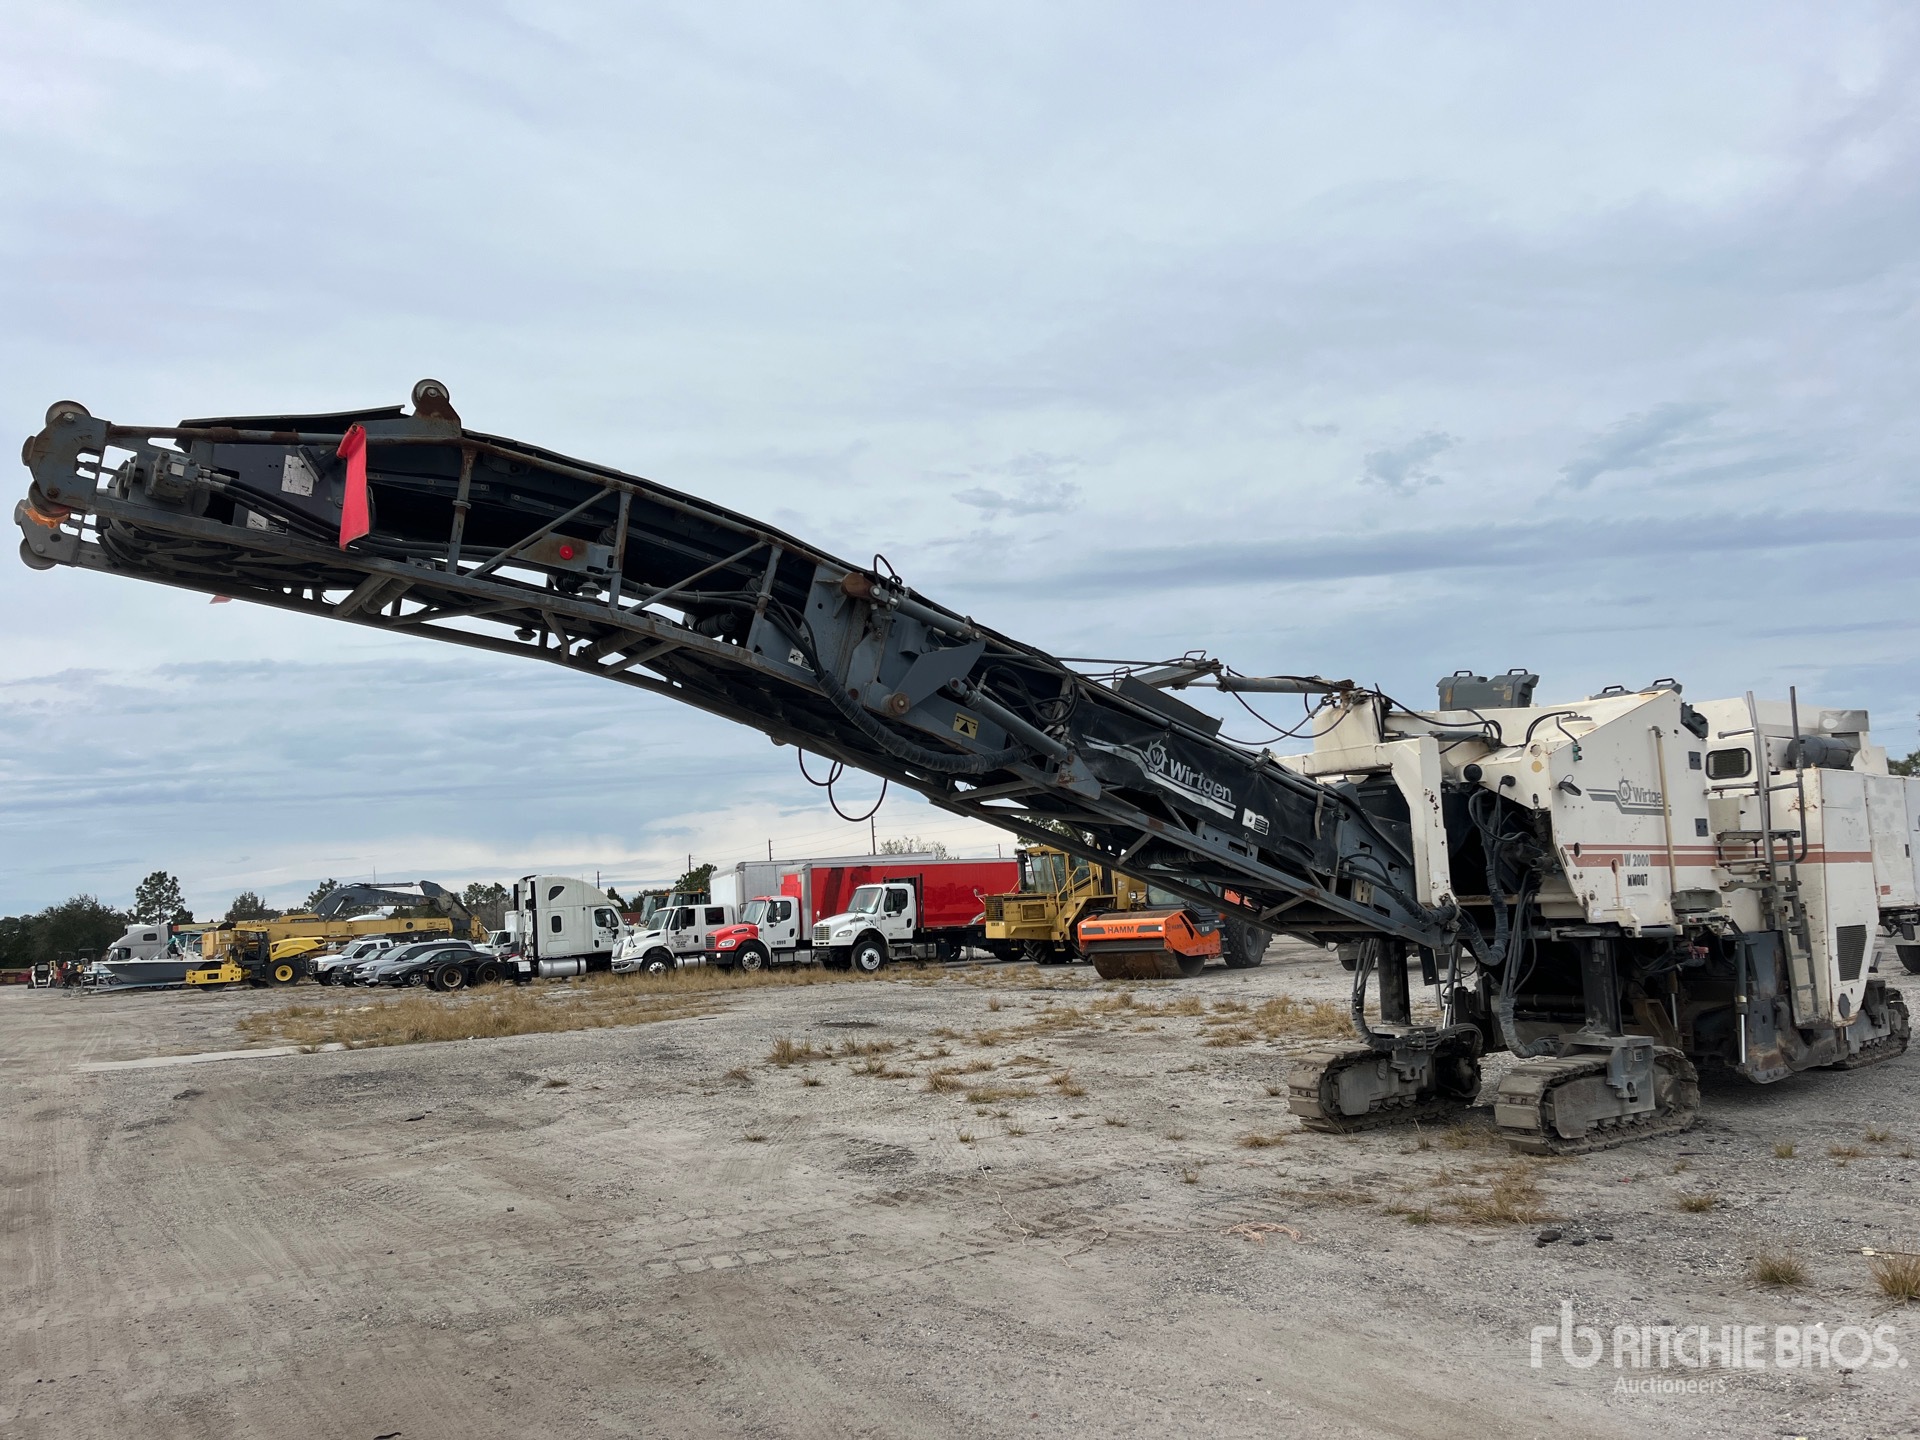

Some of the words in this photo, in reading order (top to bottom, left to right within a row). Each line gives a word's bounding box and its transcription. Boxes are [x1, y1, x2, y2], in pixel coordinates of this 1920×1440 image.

[1170, 758, 1232, 802] Wirtgen
[1632, 787, 1662, 807] Wirtge
[1624, 854, 1631, 867] W
[1632, 854, 1649, 867] 2000
[1107, 925, 1135, 934] HAMM
